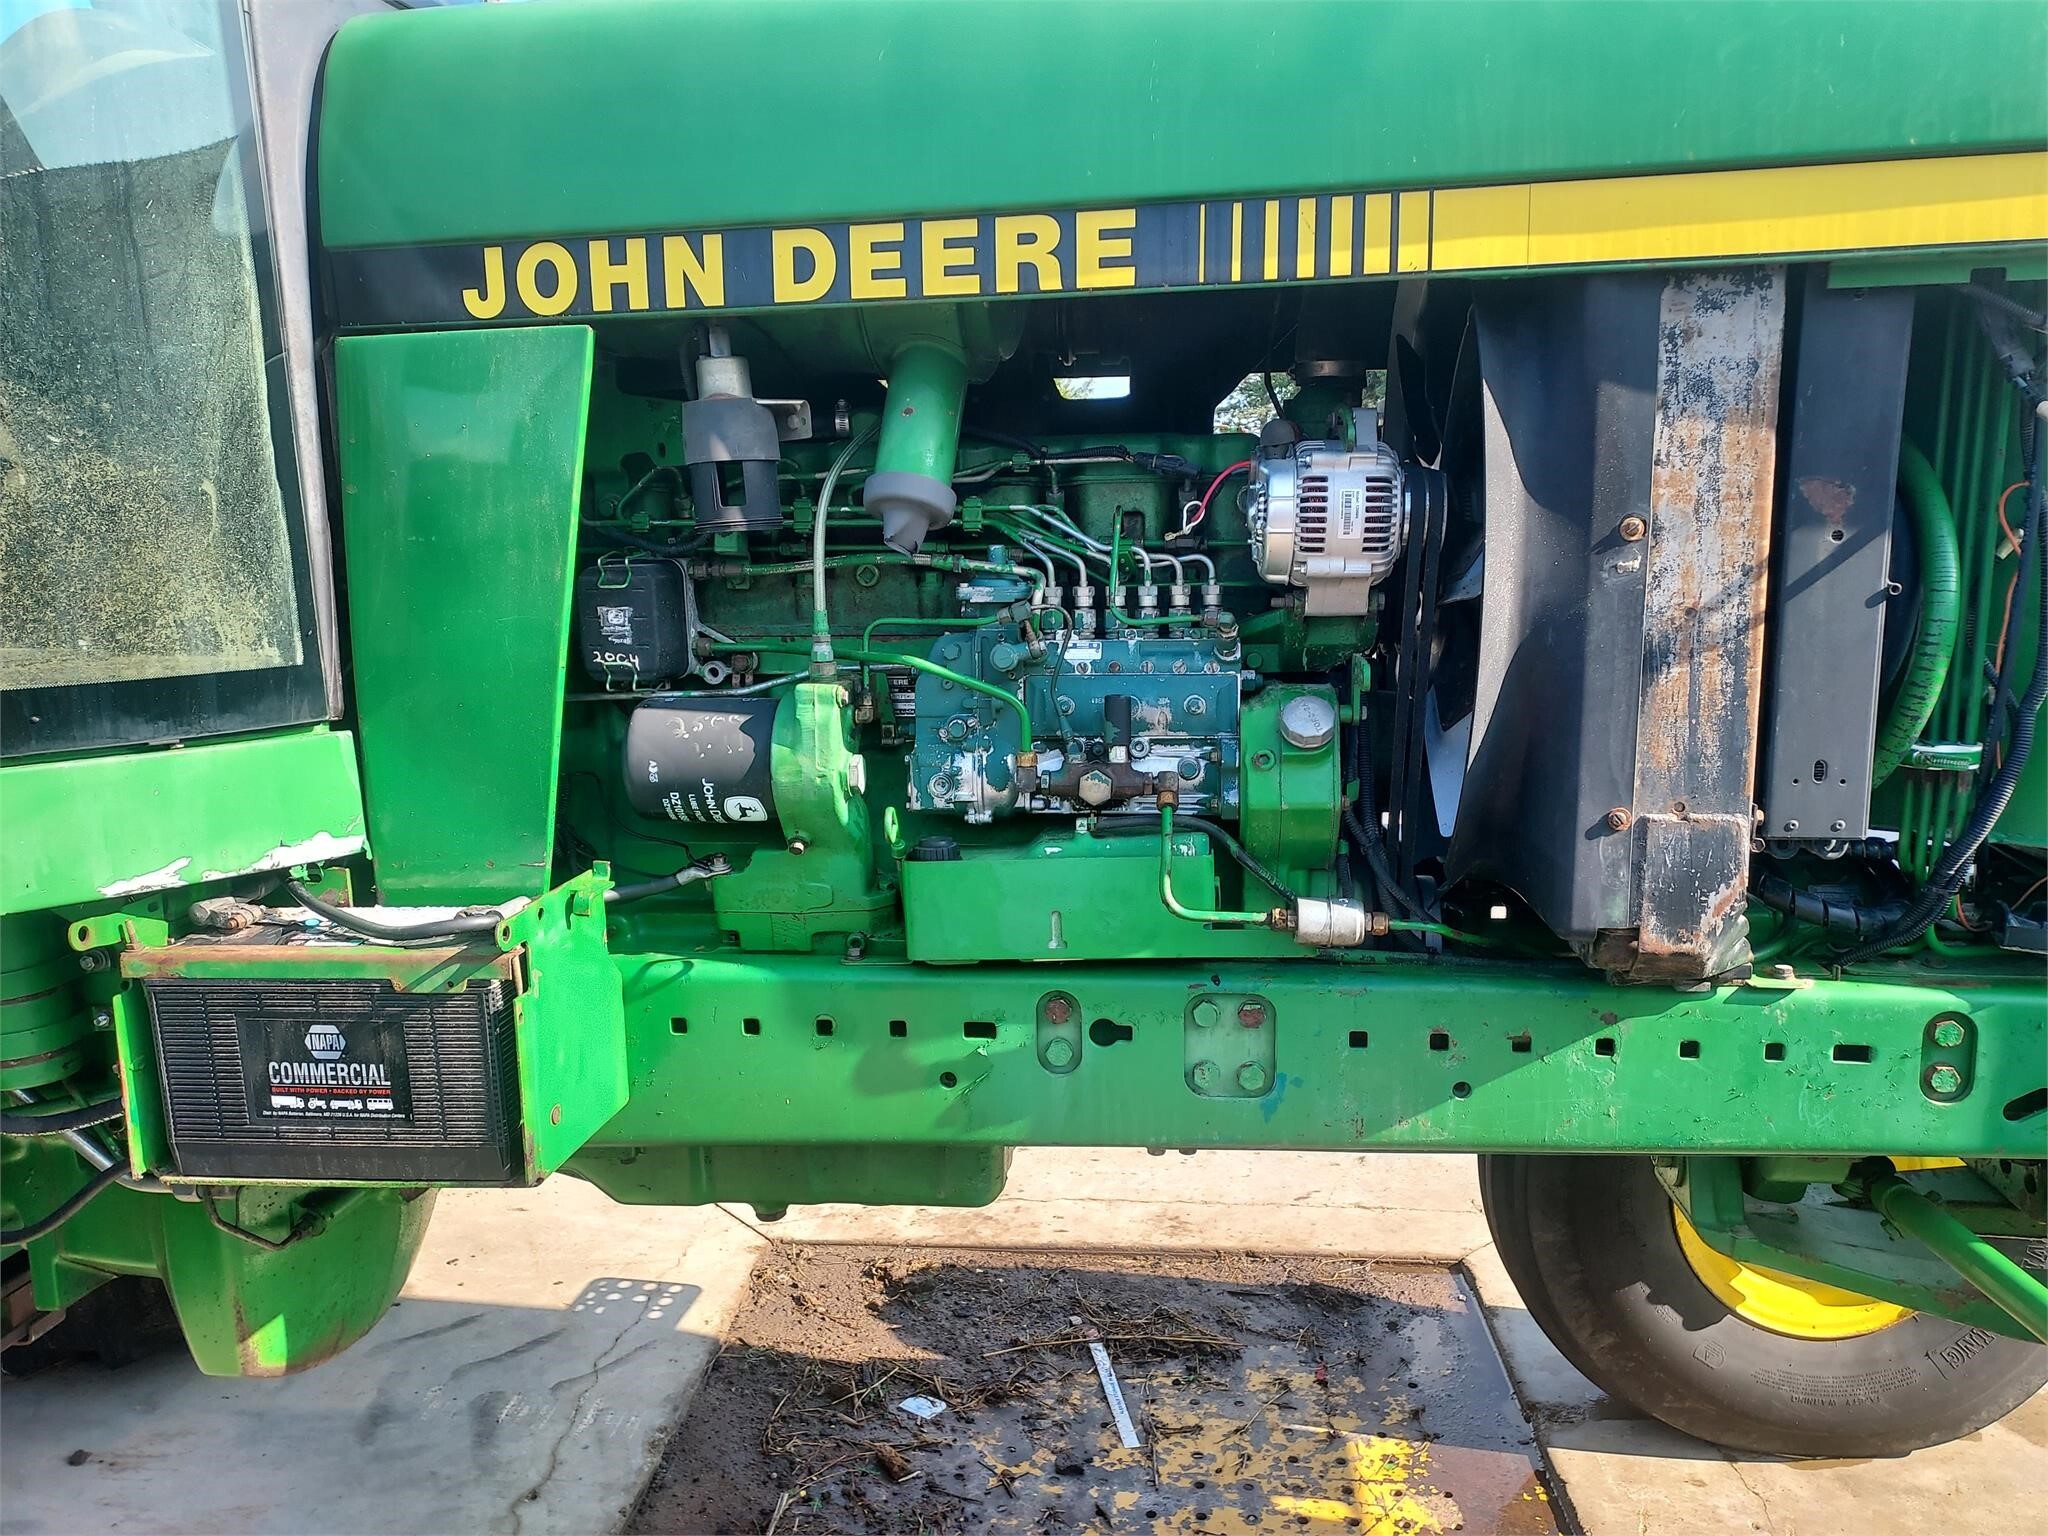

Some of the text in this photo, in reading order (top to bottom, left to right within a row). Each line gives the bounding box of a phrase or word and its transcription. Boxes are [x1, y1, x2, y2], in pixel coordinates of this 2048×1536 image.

[462, 208, 1137, 319] JOHN DEERE
[688, 793, 699, 810] LUBE
[702, 778, 717, 809] JOHN
[311, 1033, 340, 1051] NAPA
[268, 1061, 392, 1086] COMMERCIAL
[271, 1086, 289, 1094] BUILT
